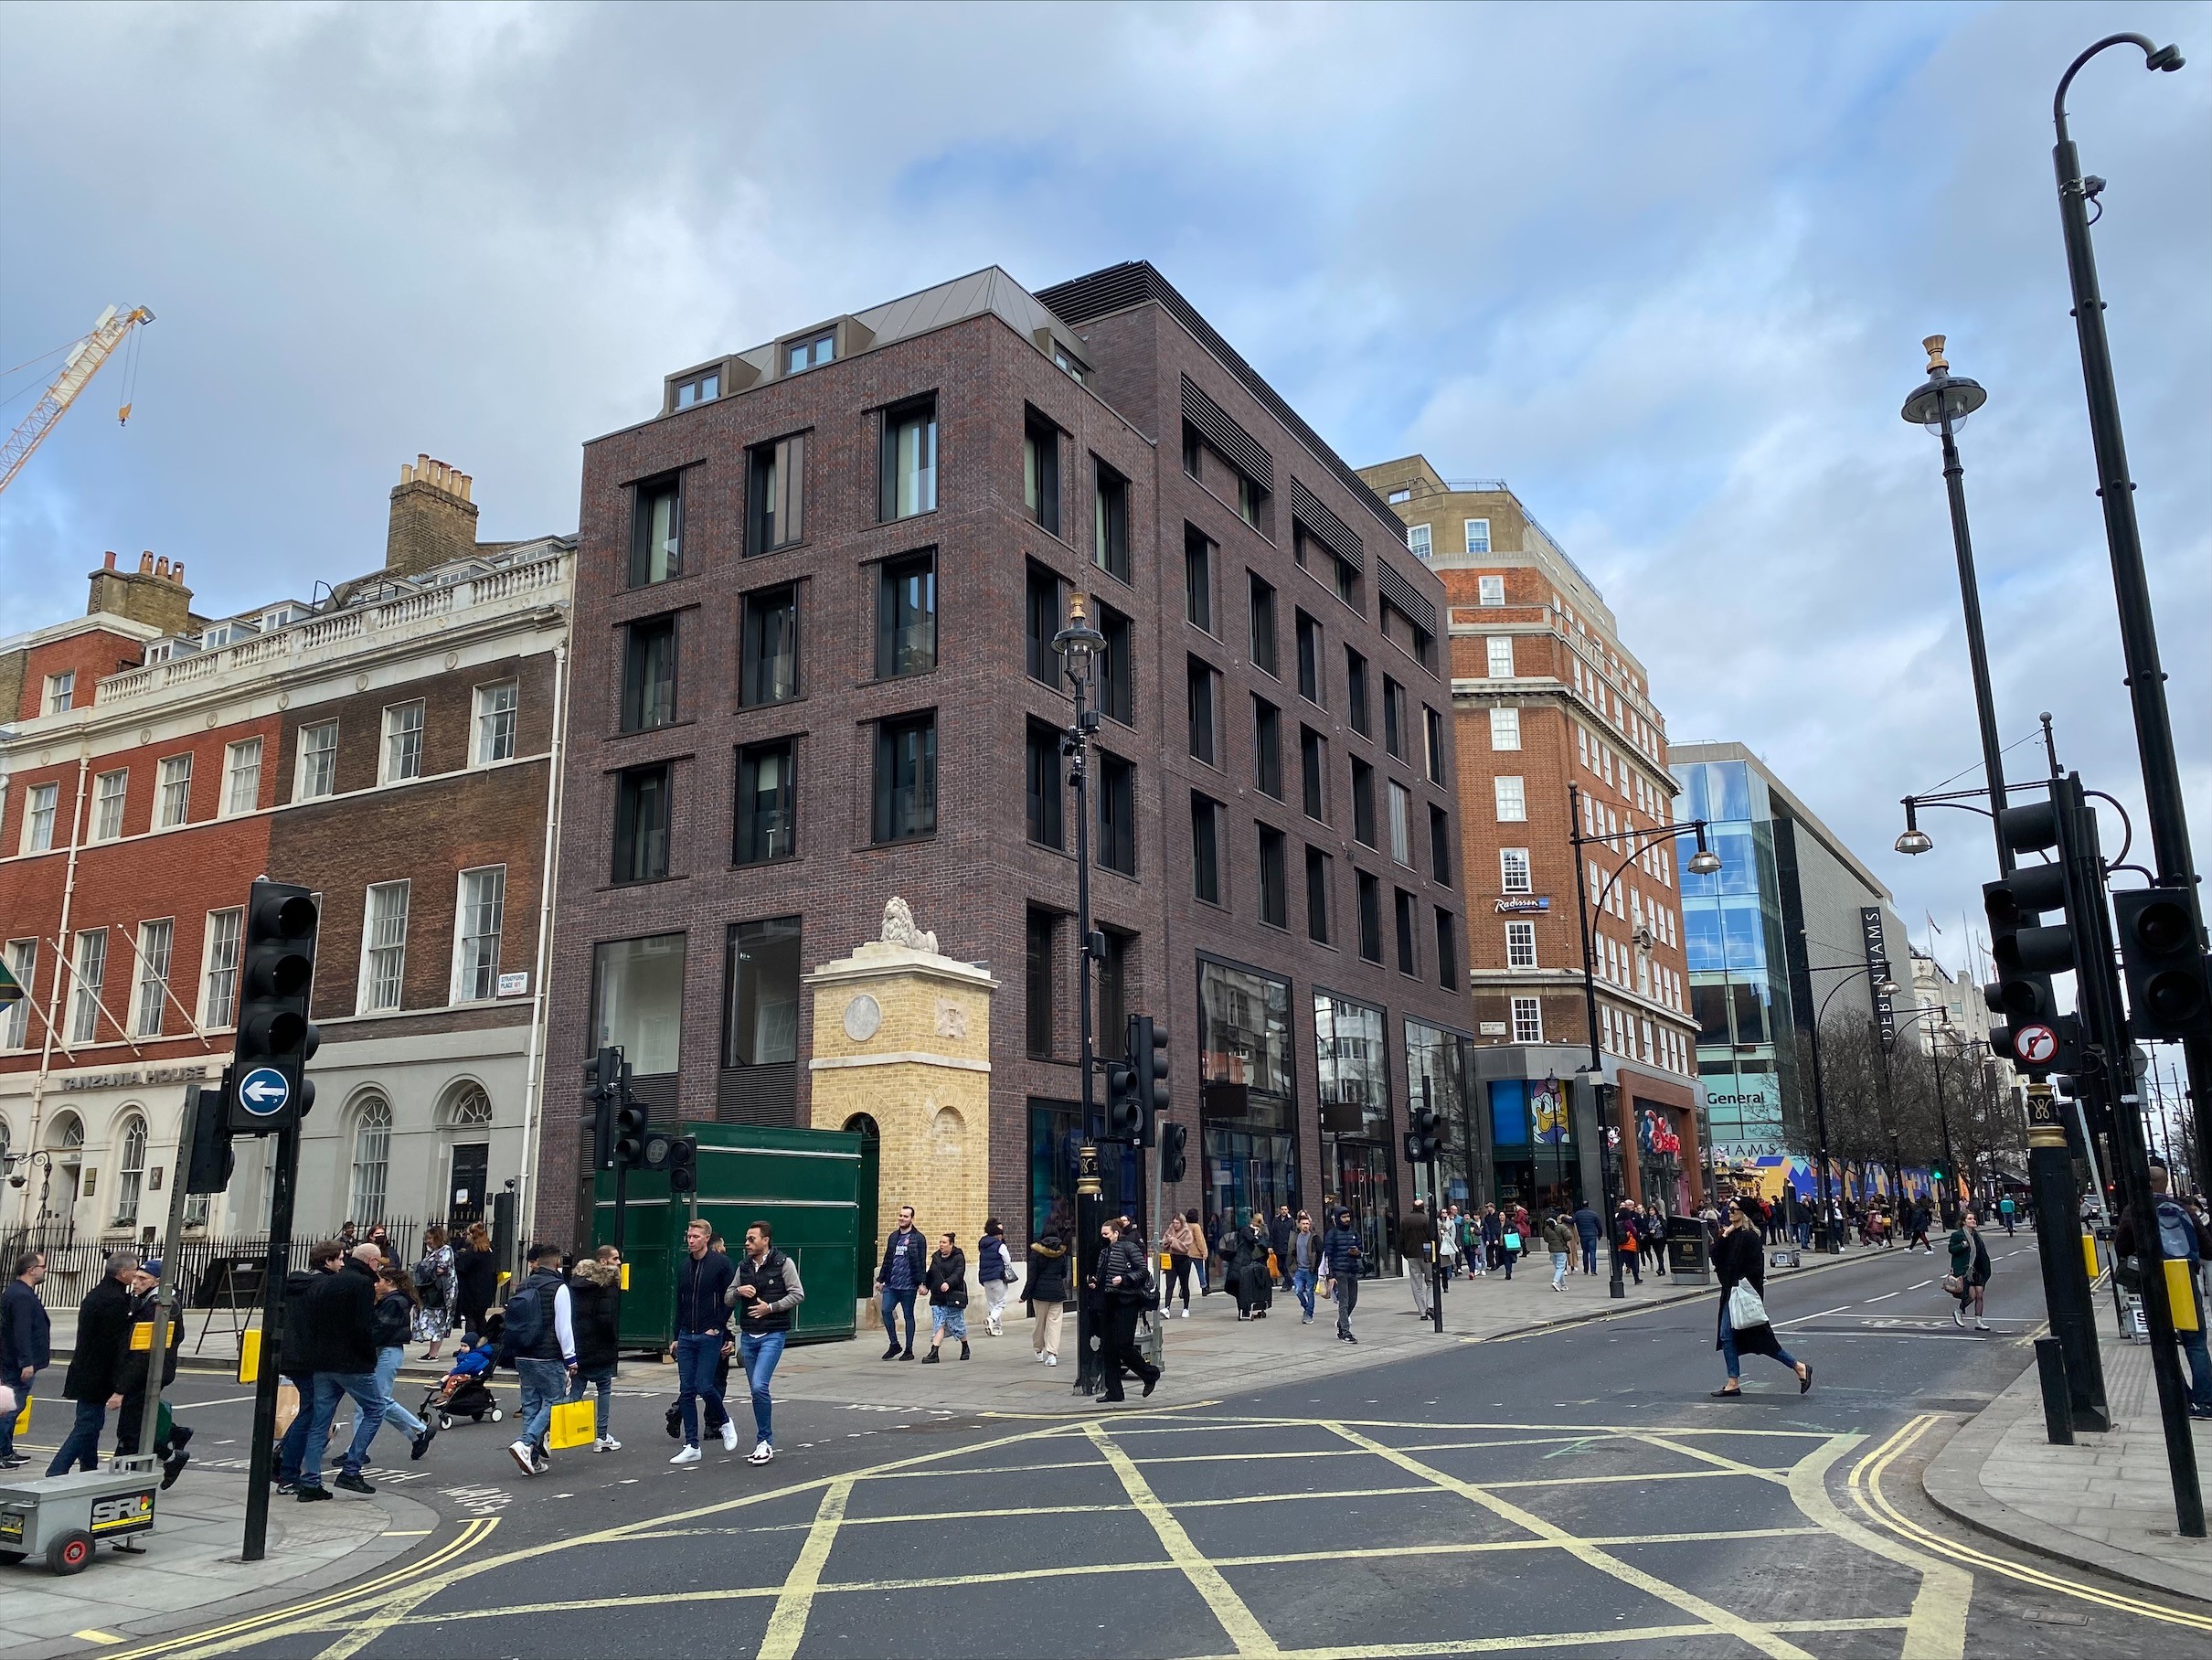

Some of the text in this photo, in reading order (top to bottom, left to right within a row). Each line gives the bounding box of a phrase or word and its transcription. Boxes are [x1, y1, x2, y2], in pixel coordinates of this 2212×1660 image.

[1494, 897, 1538, 913] Radisson
[59, 1066, 207, 1091] TANZANIA HOUSE
[1707, 1091, 1765, 1104] General
[1093, 1193, 1103, 1202] 14
[92, 1496, 152, 1523] SRL
